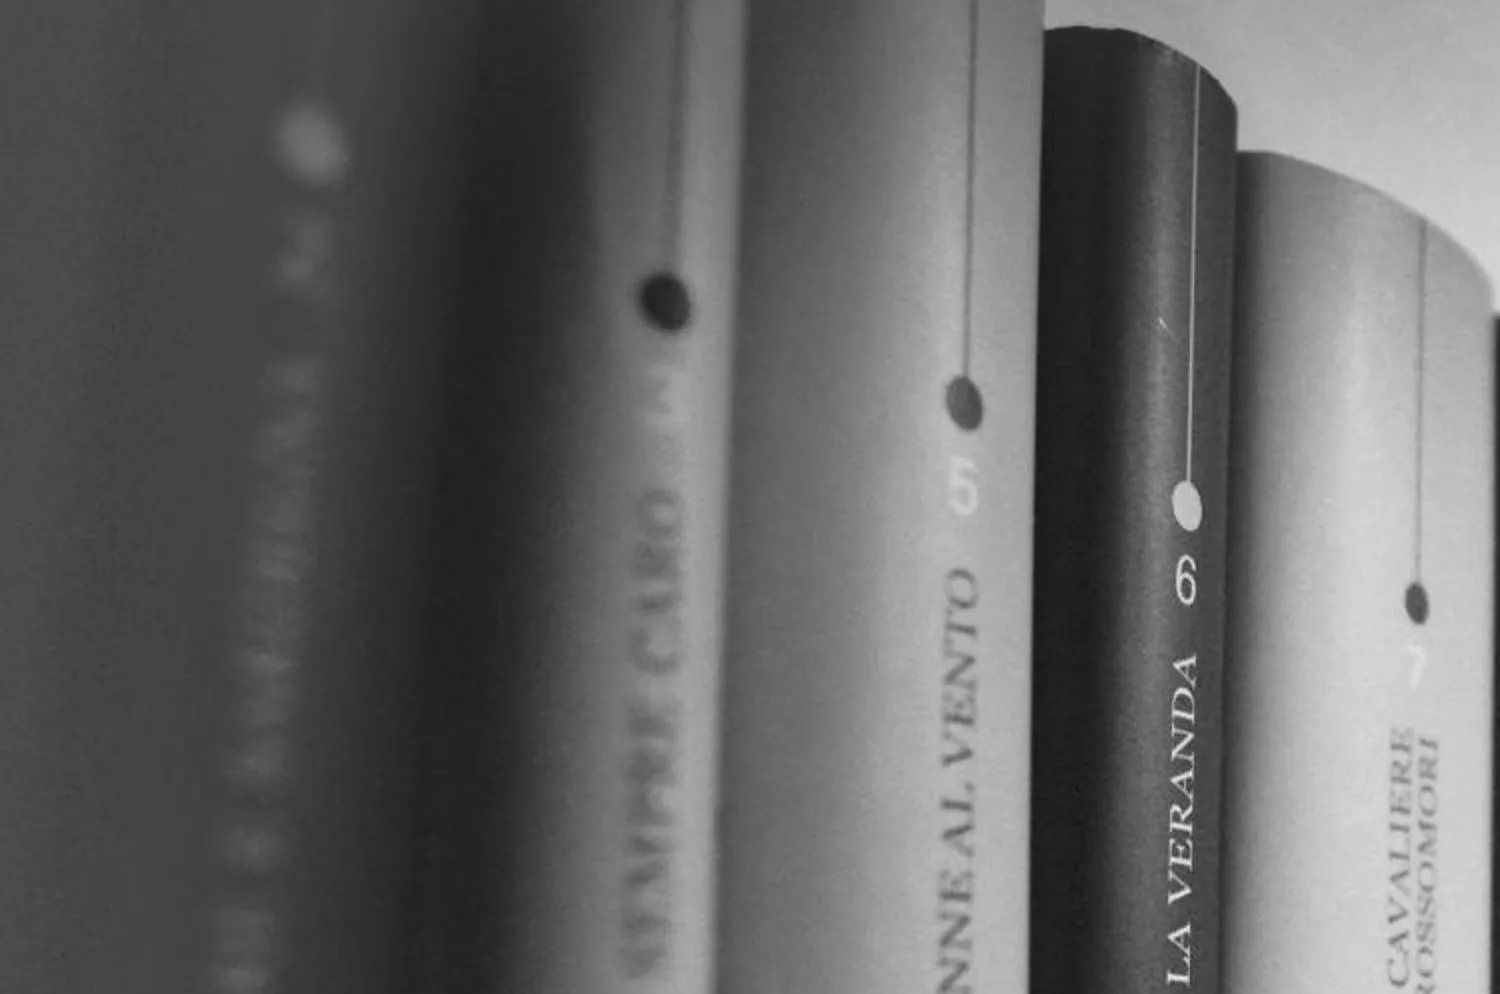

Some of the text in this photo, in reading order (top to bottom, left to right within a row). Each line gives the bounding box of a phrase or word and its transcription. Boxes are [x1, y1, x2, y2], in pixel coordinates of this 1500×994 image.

[945, 455, 981, 515] 5
[1175, 553, 1198, 607] 6
[940, 567, 981, 769] VENTO
[937, 780, 979, 857] AL
[1165, 651, 1198, 987] LA VERANDA
[1385, 726, 1415, 990] CAVALIERE
